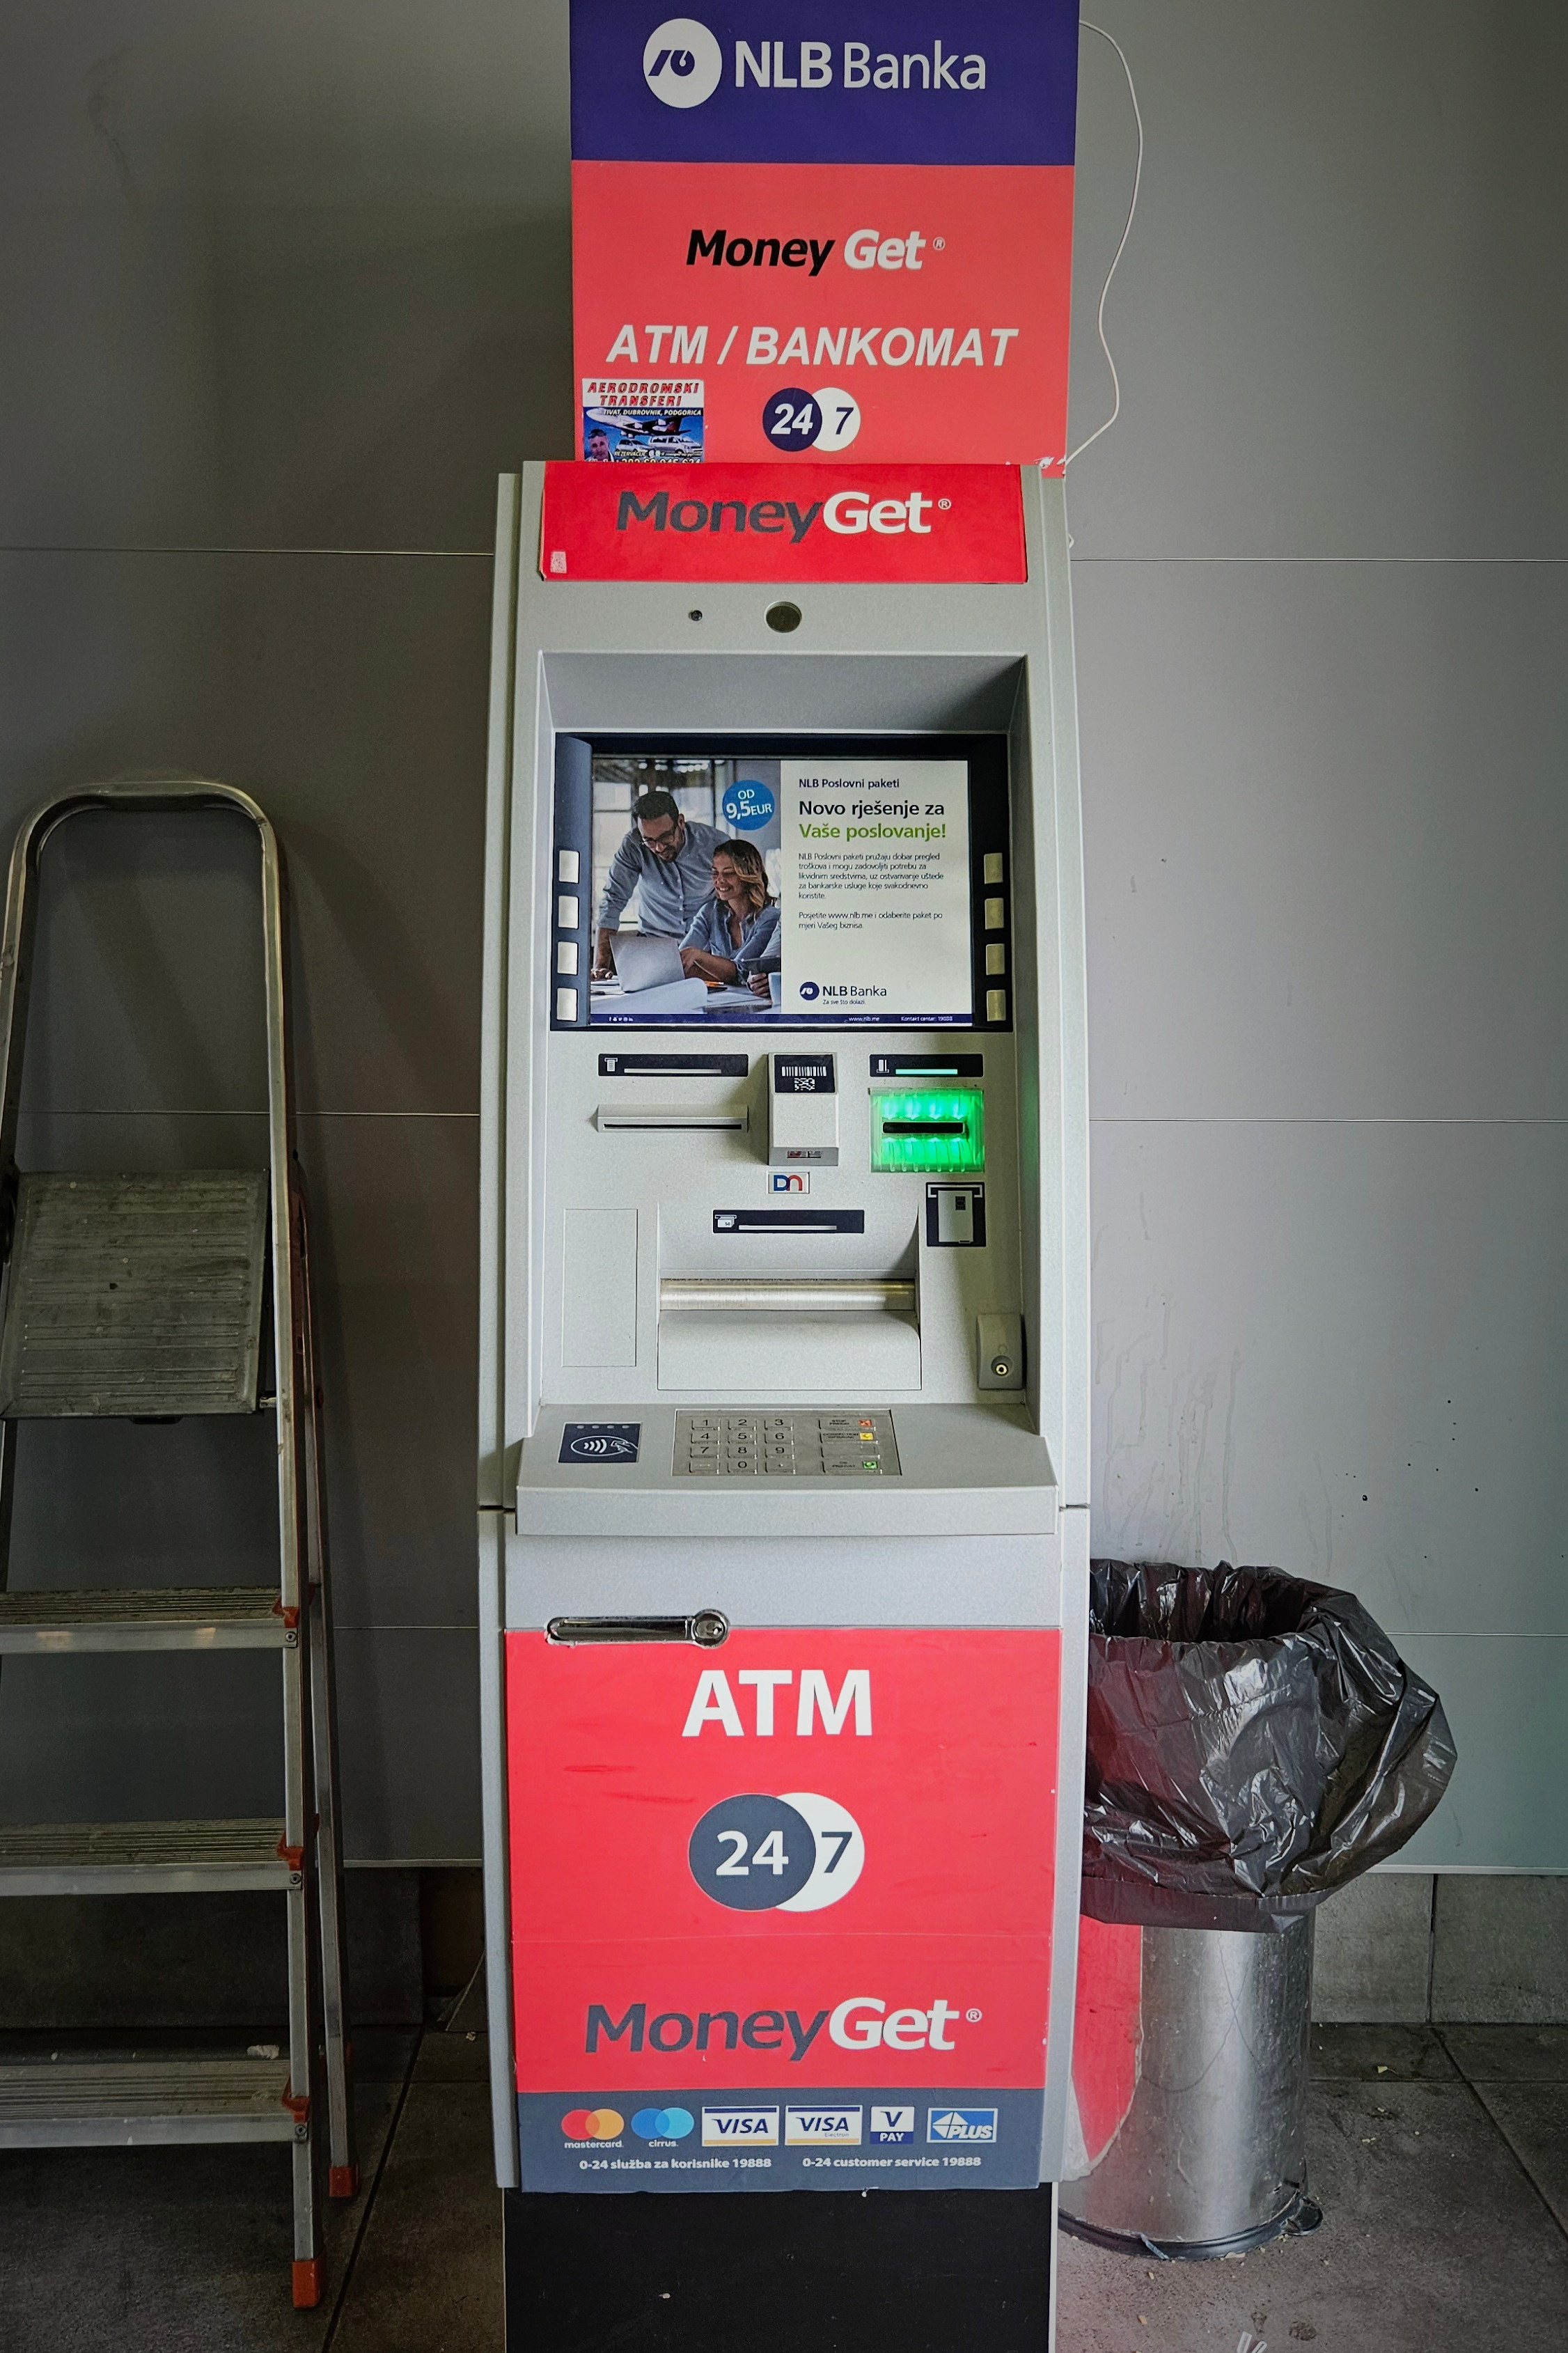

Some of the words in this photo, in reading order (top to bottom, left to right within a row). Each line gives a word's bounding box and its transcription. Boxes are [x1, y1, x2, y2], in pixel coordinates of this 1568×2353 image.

[735, 41, 833, 88] NLB
[843, 40, 987, 91] Banka
[686, 229, 836, 276] Money
[843, 228, 927, 270] Get
[606, 325, 709, 364] ATM
[746, 326, 1019, 367] BANKOMAT
[588, 382, 699, 393] AERODROMSKI
[600, 395, 682, 407] TRANSFERI
[770, 403, 813, 435] 24
[834, 407, 855, 435] 7
[799, 779, 819, 788] NLB
[822, 779, 864, 788] Poslovni
[868, 779, 900, 790] paketi
[738, 789, 755, 799] OD
[799, 801, 845, 815] Novo
[852, 800, 919, 819] rješenje
[925, 804, 944, 815] za
[799, 823, 840, 838] Vaše
[846, 823, 946, 842] poslovanje!
[843, 853, 863, 861] paketi
[865, 853, 891, 861] pružaju
[914, 853, 940, 861] pregled
[879, 873, 919, 881] ostvarivanje
[844, 882, 866, 891] usluge
[868, 882, 882, 891] koje
[823, 986, 847, 996] NLB
[851, 985, 887, 996] Banka
[682, 1669, 872, 1737] ATM
[715, 1830, 789, 1875] 24
[821, 1831, 853, 1874] 7
[712, 2118, 769, 2134] VISA
[796, 2117, 849, 2132] VISA
[880, 2111, 903, 2127] V
[879, 2133, 904, 2143] PAY
[947, 2125, 994, 2140] PLUS
[579, 2159, 608, 2169] 0-24
[611, 2159, 652, 2169] služba
[671, 2158, 730, 2168] korisnike
[732, 2158, 771, 2168] 19888
[802, 2157, 831, 2167] 0-24
[833, 2158, 894, 2167] customer
[895, 2157, 939, 2167] service
[942, 2157, 982, 2166] 19888
